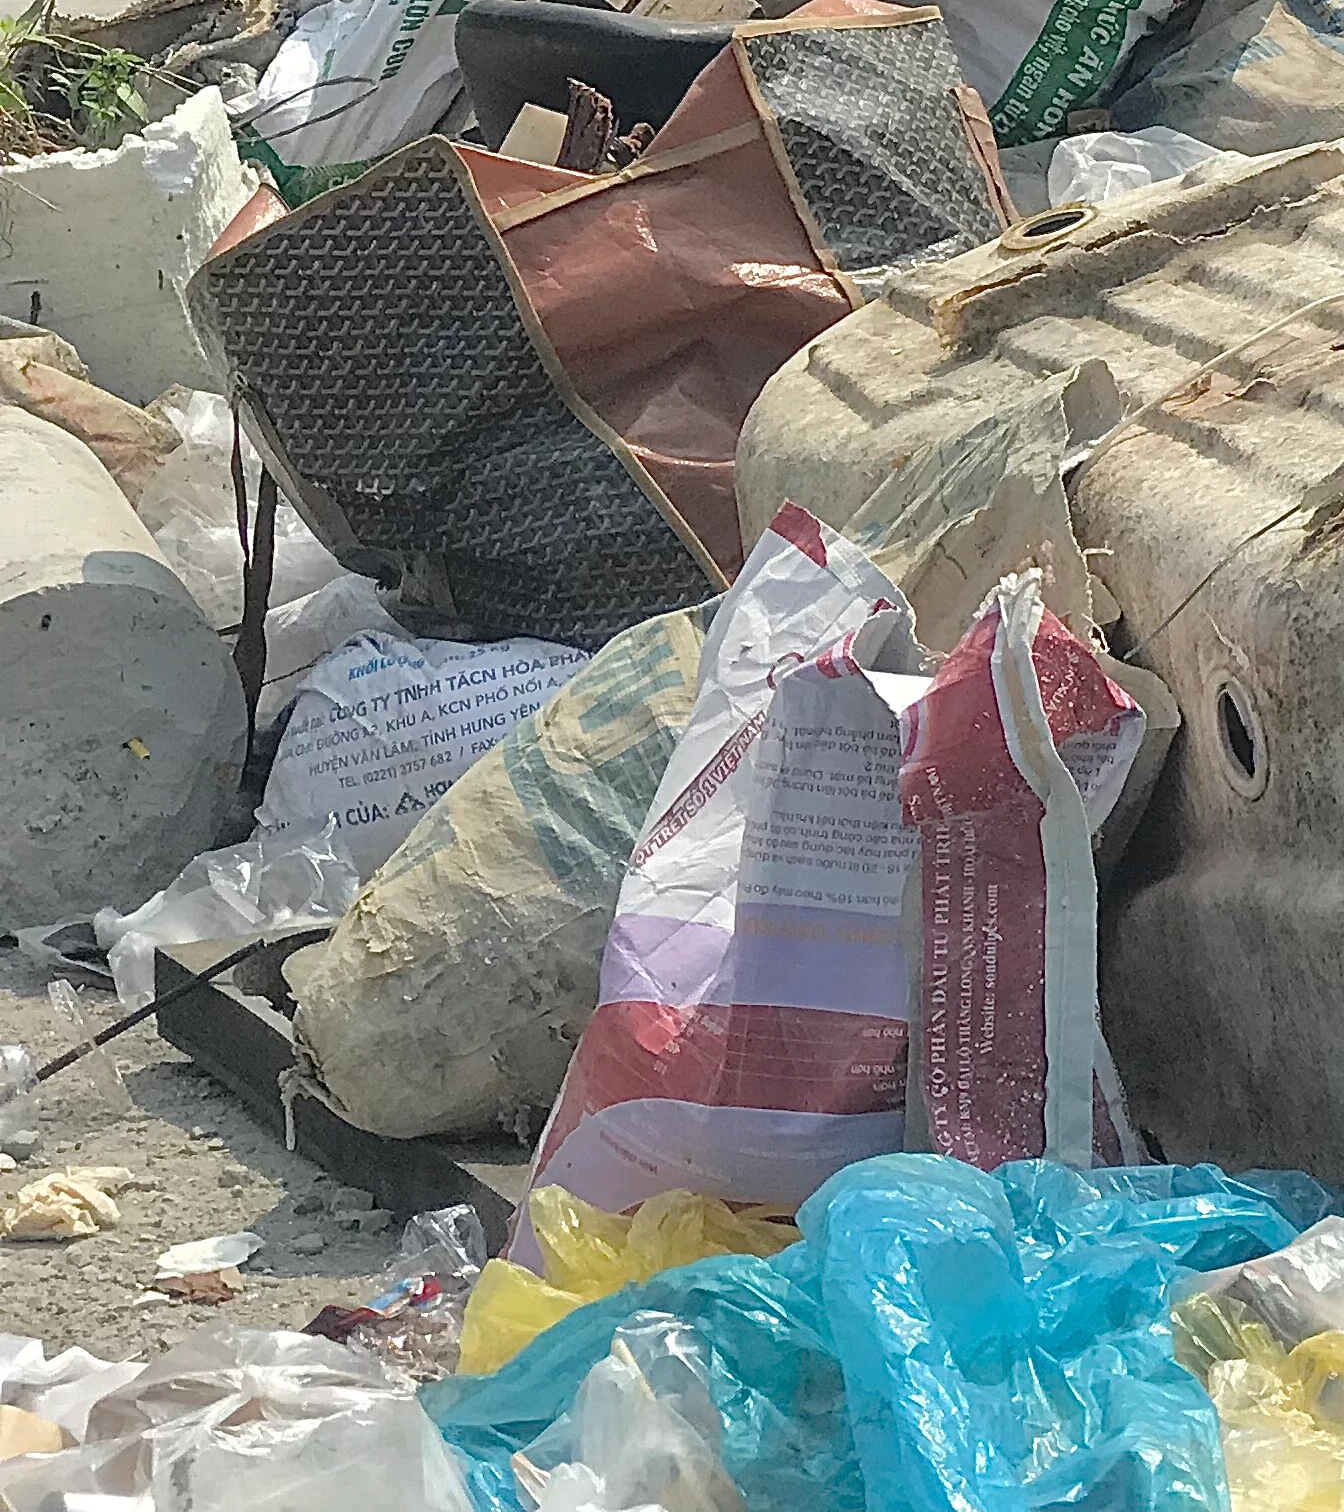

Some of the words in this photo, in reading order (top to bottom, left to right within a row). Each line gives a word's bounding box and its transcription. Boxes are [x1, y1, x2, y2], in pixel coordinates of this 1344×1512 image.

[1051, 3, 1083, 37] cho
[1010, 53, 1052, 102] ngan
[1064, 44, 1107, 92] ĂN
[370, 694, 392, 713] TY
[394, 678, 442, 704] TNHH
[444, 662, 497, 693] TĂCN
[500, 655, 545, 679] HÒA
[419, 711, 437, 725] A,
[436, 697, 473, 718] KCN
[473, 684, 510, 708] PHỐ
[510, 676, 543, 698] NỐI
[306, 753, 350, 780] HUYỆN
[420, 725, 457, 747] TỈNH
[509, 700, 543, 722] YÊN
[733, 707, 773, 751] NAM
[361, 764, 399, 787] (0221)
[428, 750, 453, 767] 682
[696, 775, 719, 798] 1
[704, 739, 749, 788] VIỆT
[864, 761, 872, 771] 2
[342, 794, 390, 828] CỦA:
[976, 991, 996, 1053] Website:
